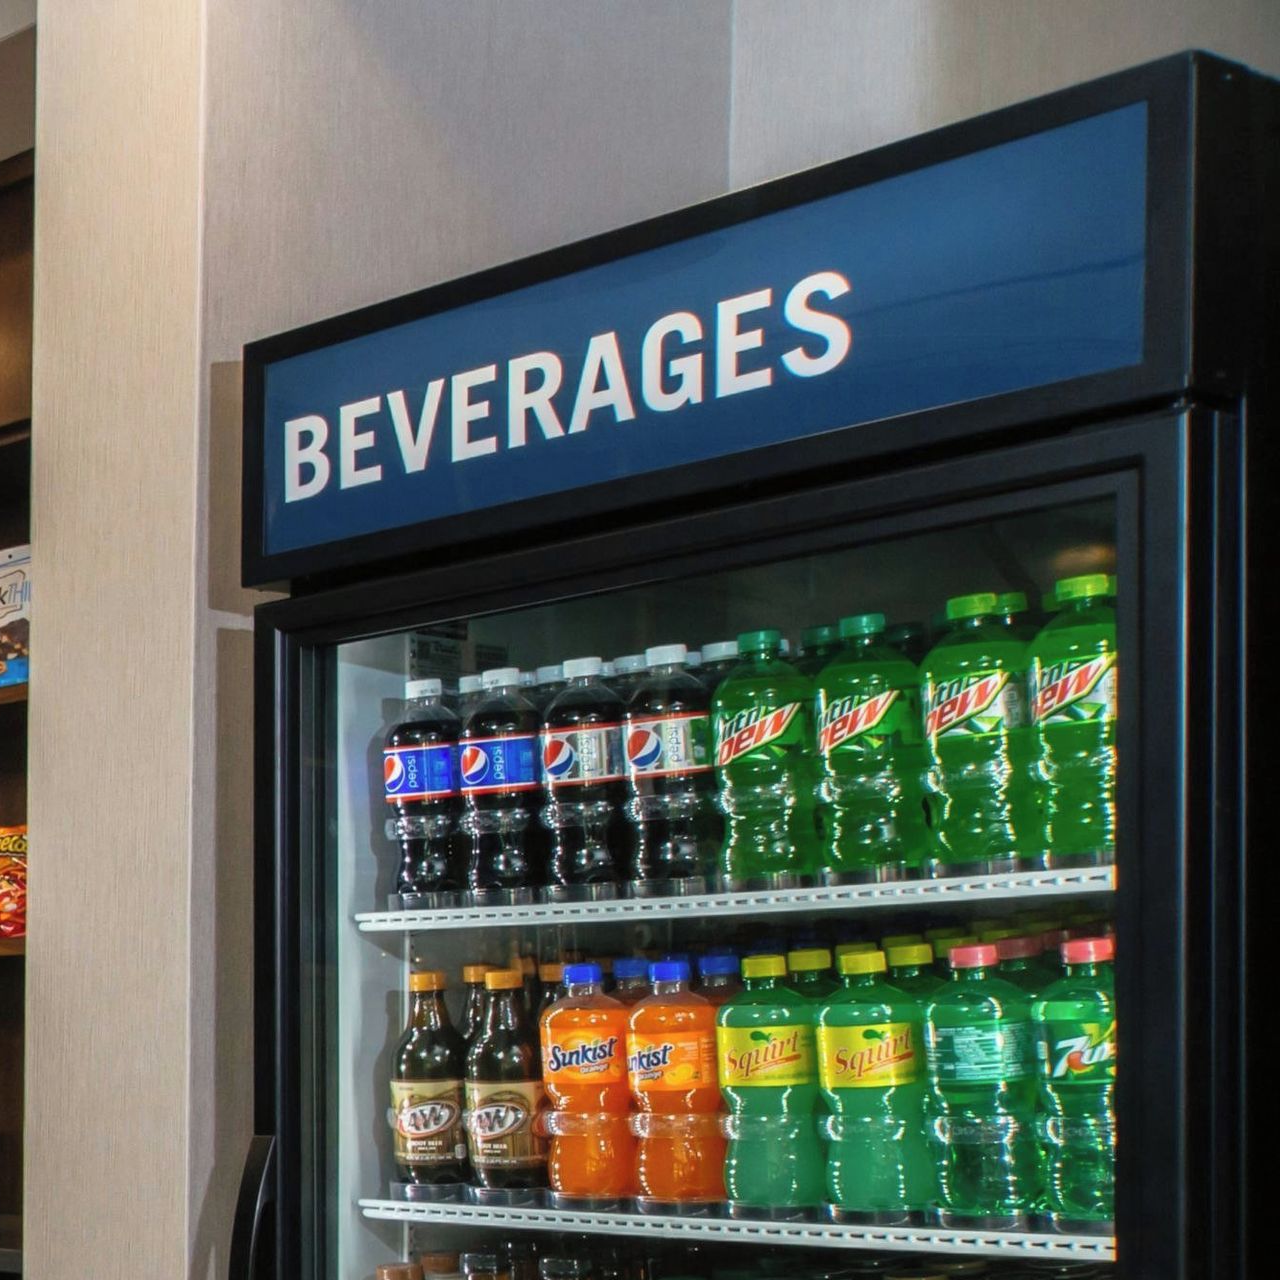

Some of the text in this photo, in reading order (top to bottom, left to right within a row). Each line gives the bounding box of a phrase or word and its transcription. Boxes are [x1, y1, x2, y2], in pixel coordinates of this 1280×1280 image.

[284, 271, 852, 504] BEVERAGES
[494, 745, 505, 781] pepsi
[670, 725, 684, 763] pepsi
[407, 754, 418, 789] pepsi
[548, 1037, 618, 1073] Sunkist
[727, 1032, 799, 1077] Squirt
[835, 1028, 912, 1078] Squirt
